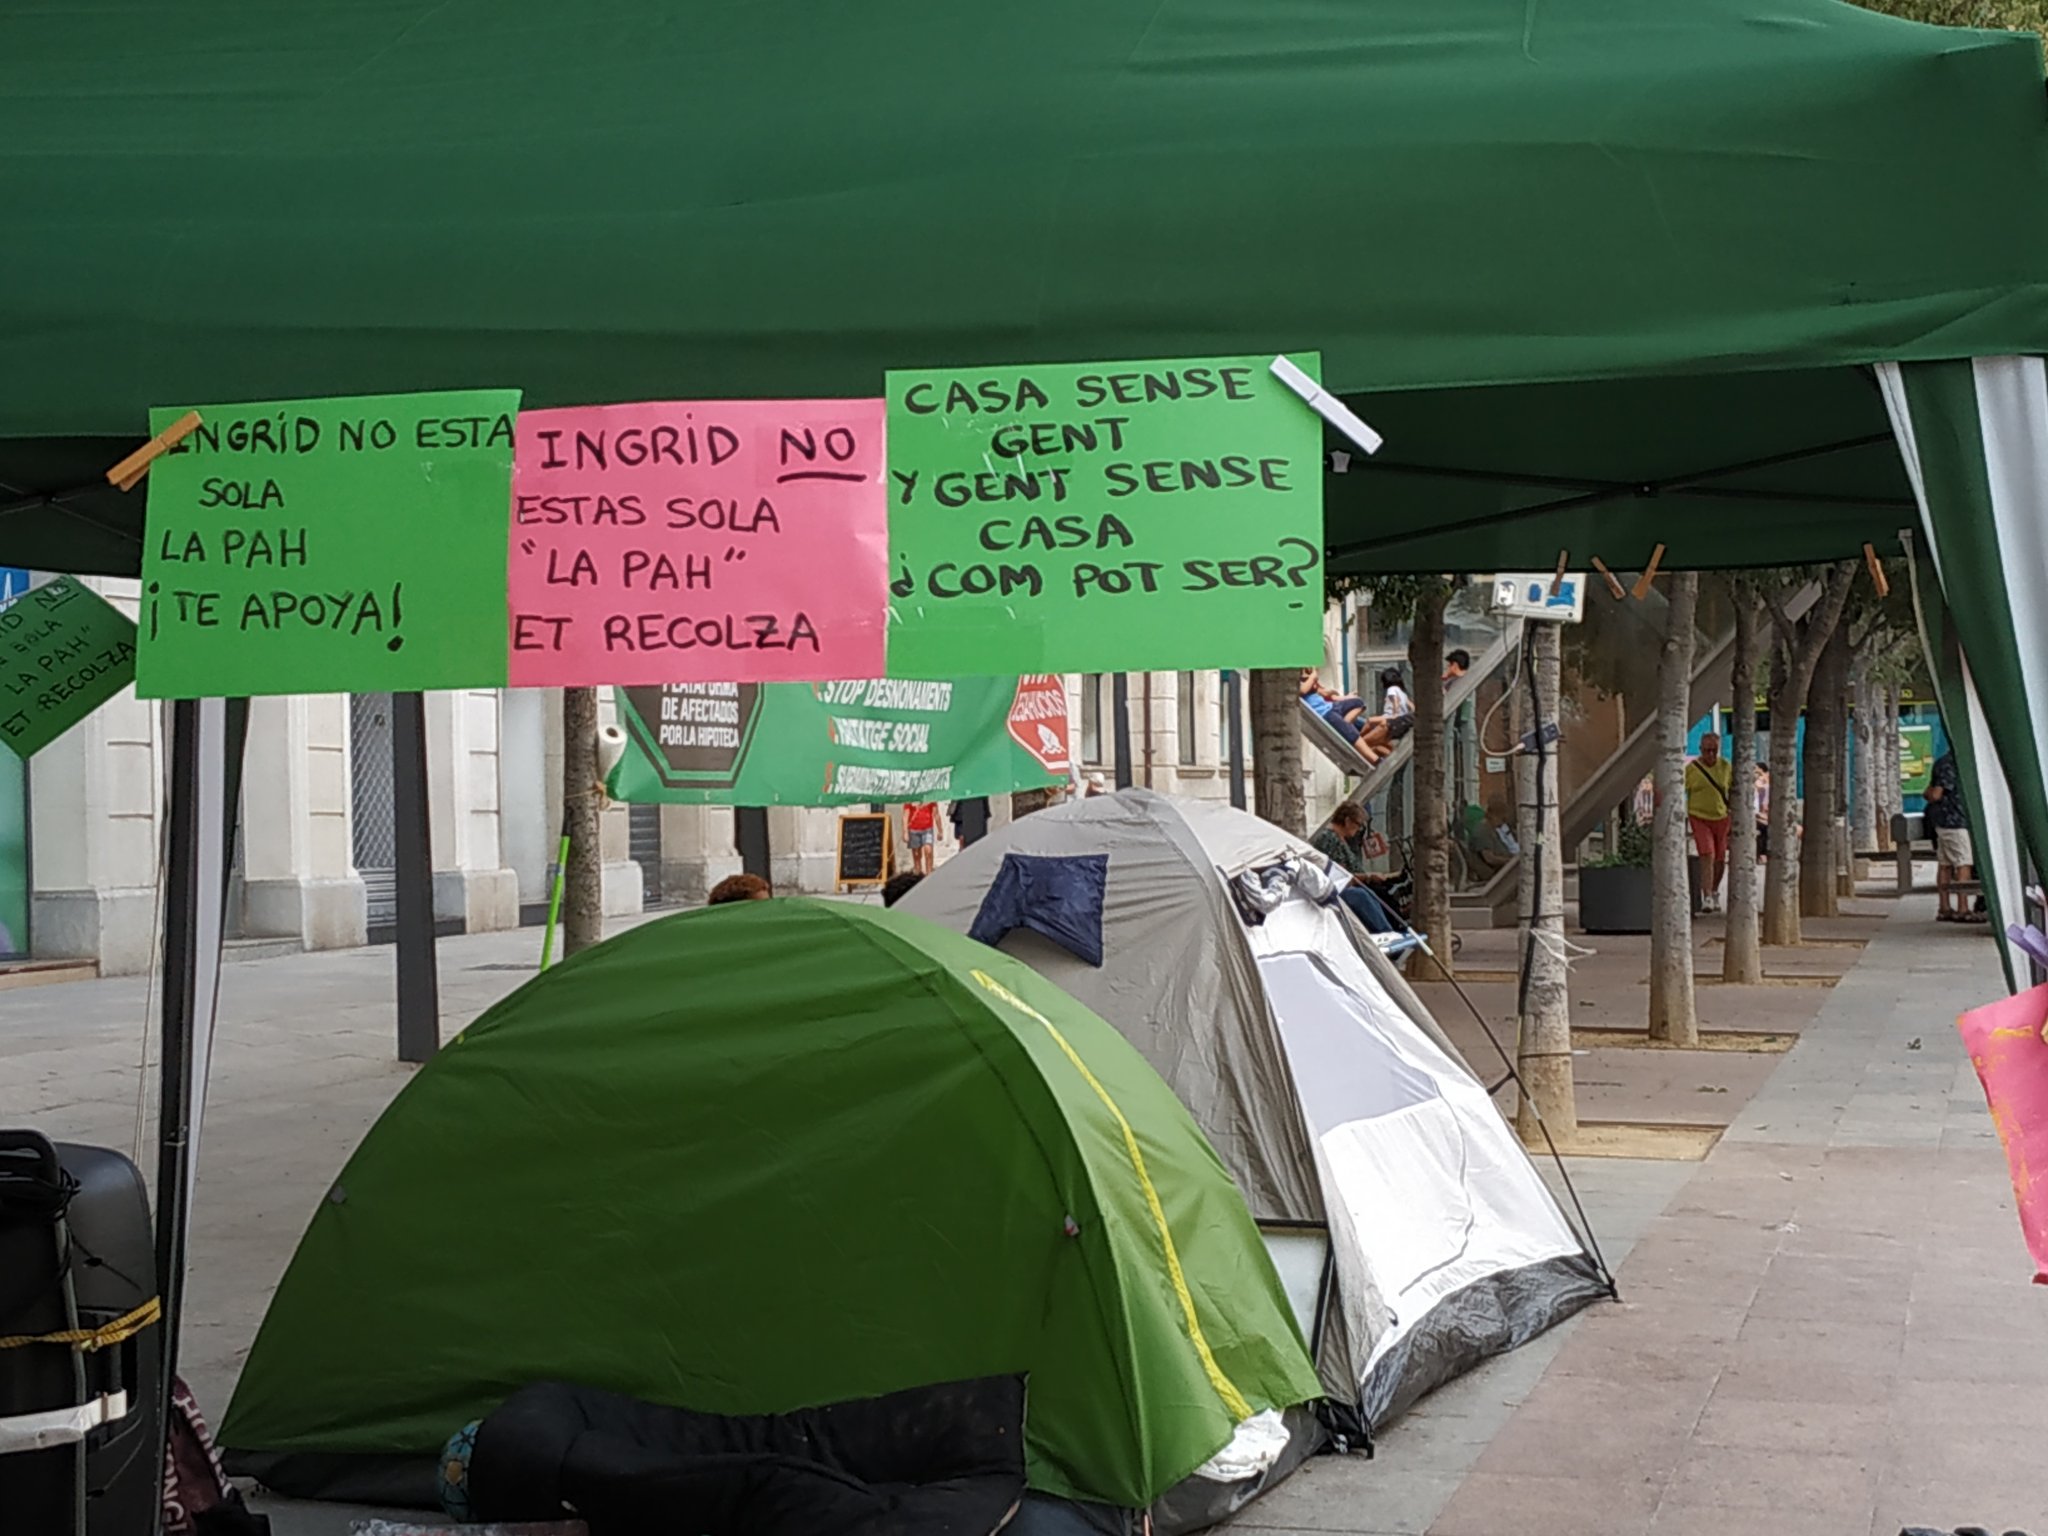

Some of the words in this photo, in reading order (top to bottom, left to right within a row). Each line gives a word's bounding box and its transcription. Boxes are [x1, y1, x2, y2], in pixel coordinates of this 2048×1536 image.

[904, 379, 1049, 415] CASA
[1077, 368, 1255, 408] SENSE
[340, 419, 397, 451] NO
[416, 414, 515, 449] ESTA
[779, 426, 857, 466] NO
[991, 417, 1129, 458] GENT
[198, 477, 285, 509] SOLA
[891, 469, 919, 505] Y
[934, 468, 1071, 507] GENT
[1104, 456, 1294, 497] SENSE
[516, 495, 647, 526] ESTAS
[666, 496, 781, 533] SOLA
[979, 514, 1134, 550] CASA
[160, 529, 207, 563] LA
[222, 528, 307, 569] PAH
[1073, 562, 1164, 599] POT
[1181, 537, 1320, 610] SER?
[148, 581, 221, 642] ¡TE
[239, 581, 405, 652] APOYA!
[513, 614, 573, 651] ET
[603, 613, 821, 653] RECOLZA
[0, 709, 31, 738] ET
[38, 641, 136, 711] RECOLZA
[5, 672, 39, 696] LA
[823, 679, 868, 704] STOP
[661, 696, 679, 721] DE
[680, 697, 739, 725] AFECTADOS
[659, 723, 683, 746] POR
[683, 725, 697, 746] LA
[697, 726, 740, 748] HIPOTECA
